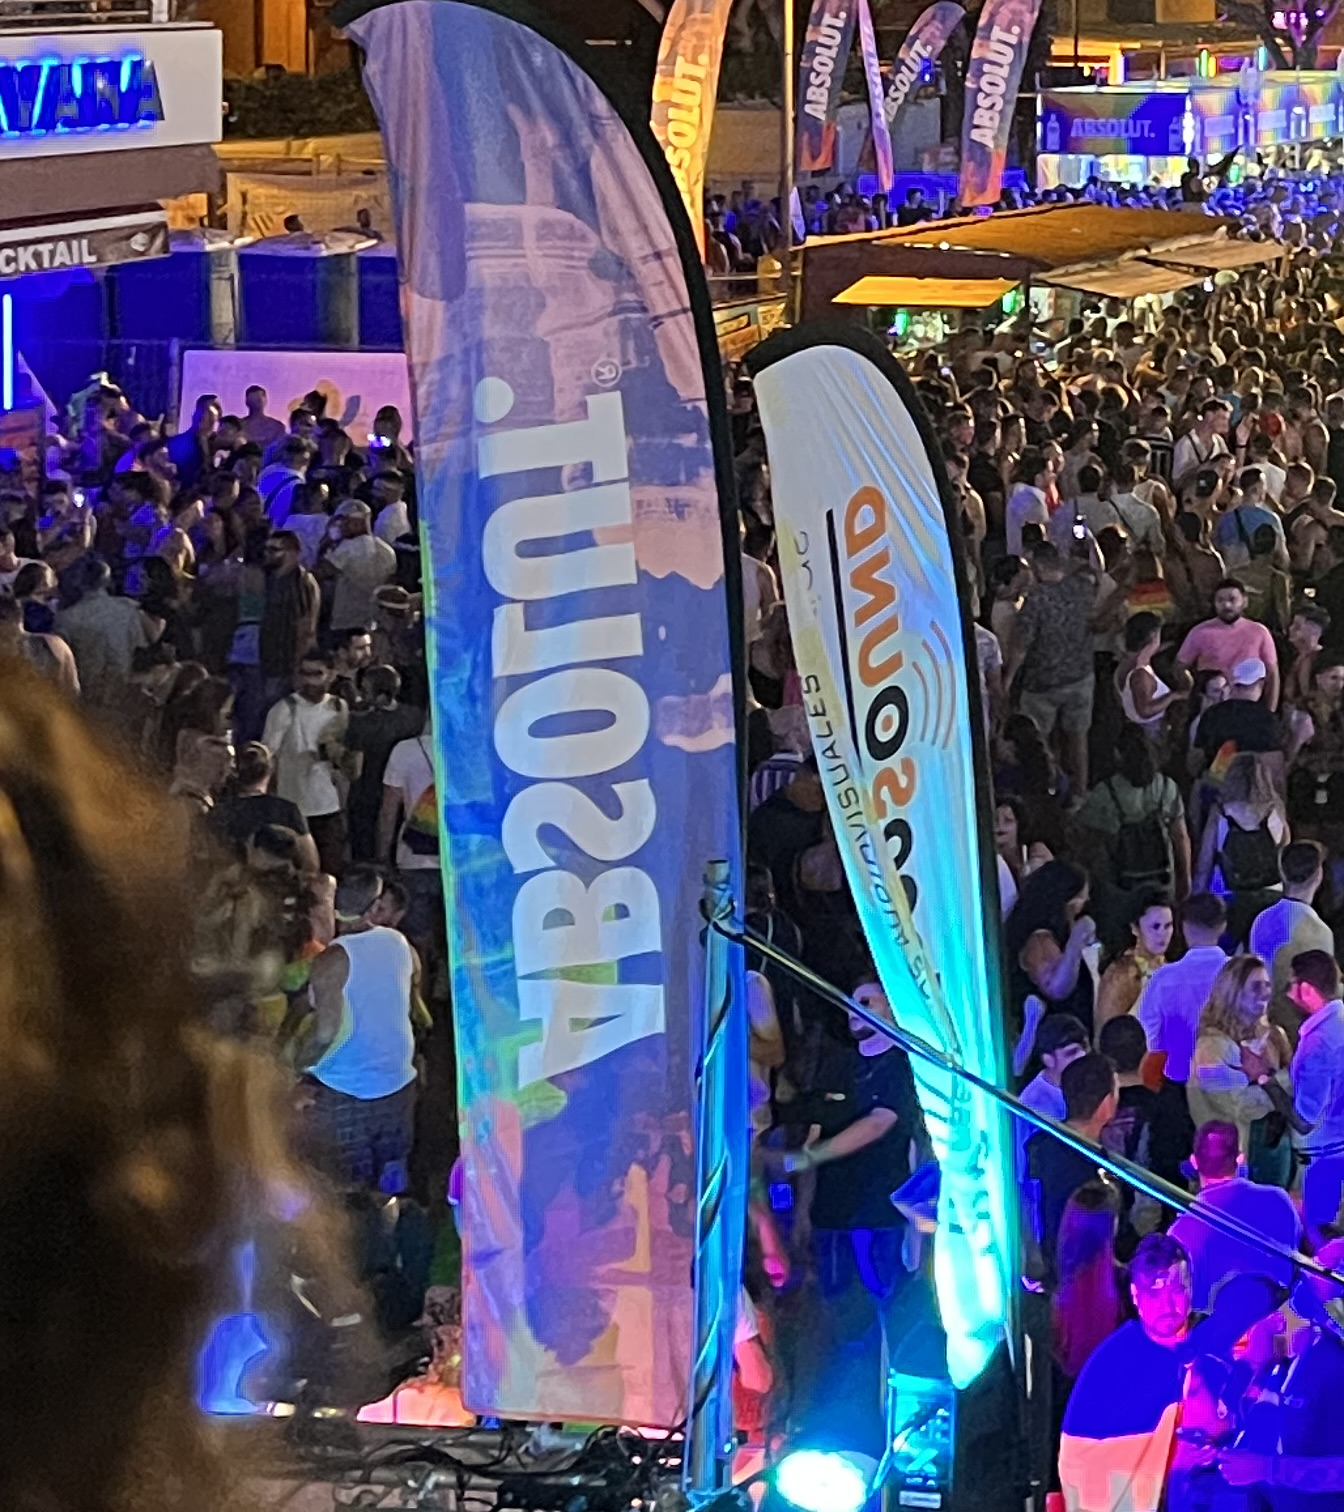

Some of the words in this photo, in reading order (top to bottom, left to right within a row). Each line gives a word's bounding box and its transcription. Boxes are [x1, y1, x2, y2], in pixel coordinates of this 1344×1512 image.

[804, 10, 847, 122] ABSOLUT.
[970, 25, 1021, 150] ABSOLUT.
[1070, 118, 1156, 139] ABSOLUT.
